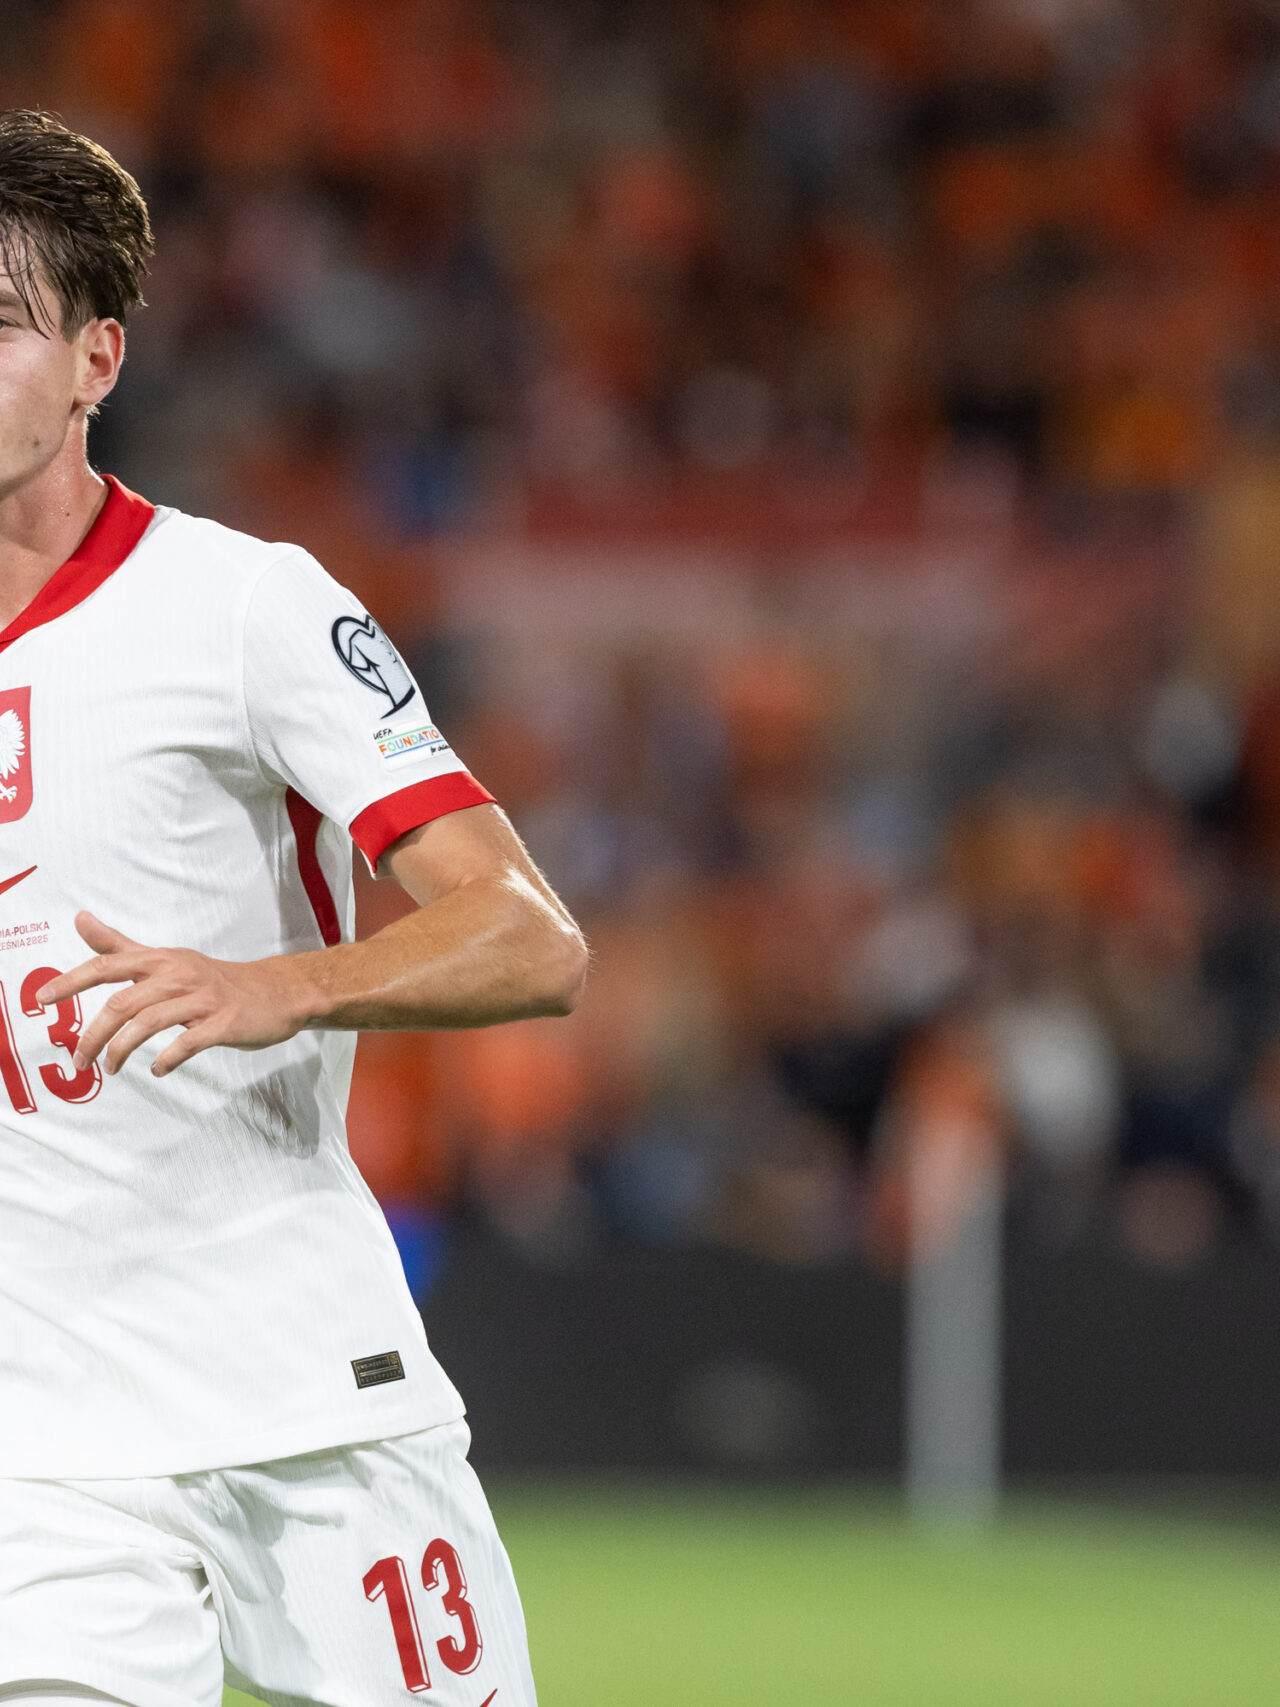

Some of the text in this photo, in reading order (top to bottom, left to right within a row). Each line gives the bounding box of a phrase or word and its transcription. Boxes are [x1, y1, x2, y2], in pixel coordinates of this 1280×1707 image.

[373, 729, 392, 740] UEFA
[26, 934, 49, 946] 2025
[362, 1537, 483, 1693] 13
